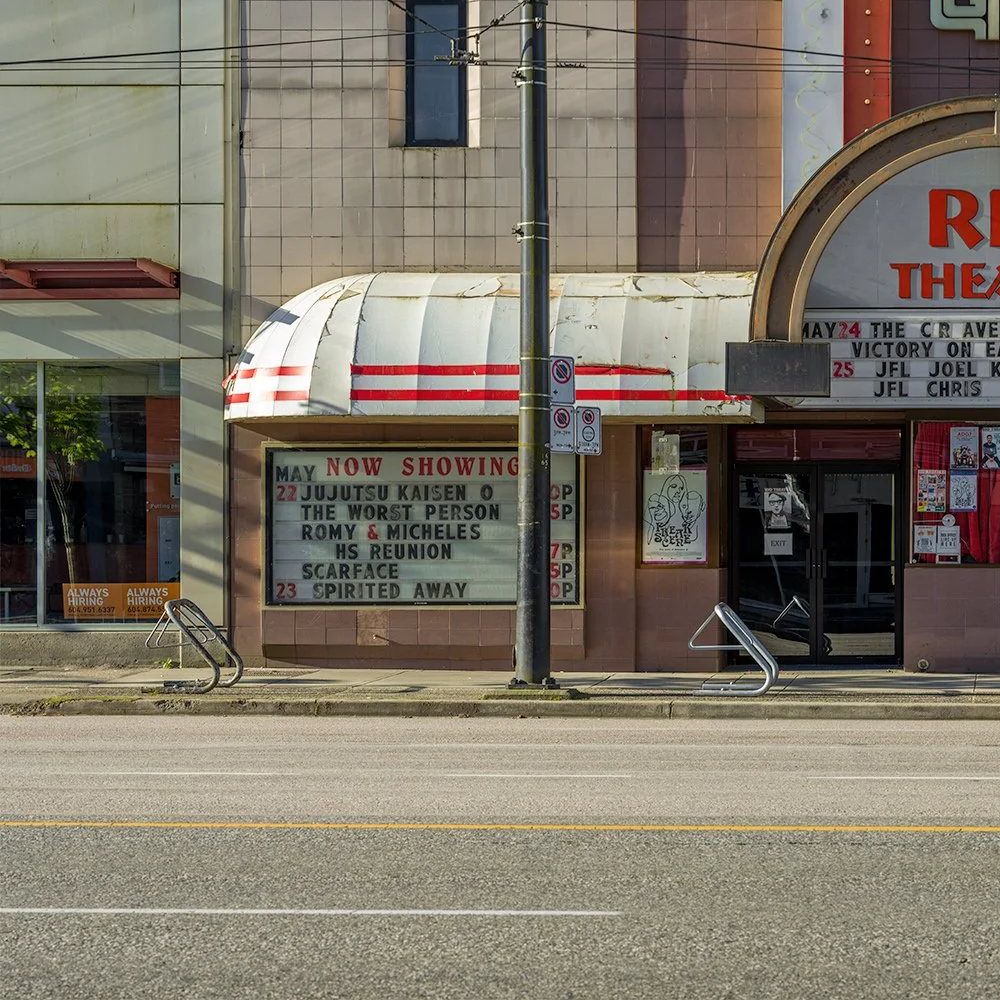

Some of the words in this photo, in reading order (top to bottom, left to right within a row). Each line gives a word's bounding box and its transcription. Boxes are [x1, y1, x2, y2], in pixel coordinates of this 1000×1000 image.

[838, 321, 861, 339] 24
[870, 322, 905, 338] THE
[851, 341, 934, 358] VICTORY
[947, 341, 971, 358] ON
[832, 361, 854, 378] 25
[876, 361, 910, 377] JFL
[929, 361, 977, 378] JOEL
[874, 380, 908, 397] JFL
[926, 380, 982, 397] CHRIS
[276, 465, 315, 482] MAY
[326, 456, 383, 476] NOW
[401, 456, 518, 476] SHOWING
[276, 484, 297, 501] 22
[300, 485, 389, 501] JUJUTSU
[398, 484, 466, 500] KAISEN
[301, 504, 336, 521] THE
[347, 504, 413, 521] WORST
[425, 504, 500, 520] PERSON
[302, 524, 356, 540] ROMY
[367, 523, 379, 540] &
[386, 523, 481, 540] MICHELES
[336, 543, 359, 560] HS
[370, 543, 452, 560] REUNION
[302, 563, 399, 579] SCARFACE
[67, 587, 110, 597] ALWAYS
[127, 587, 169, 597] ALWAYS
[276, 582, 297, 600] 23
[313, 583, 400, 599] SPIRITED
[413, 583, 468, 599] AWAY
[68, 597, 104, 606] HIRING
[127, 596, 163, 605] HIRING
